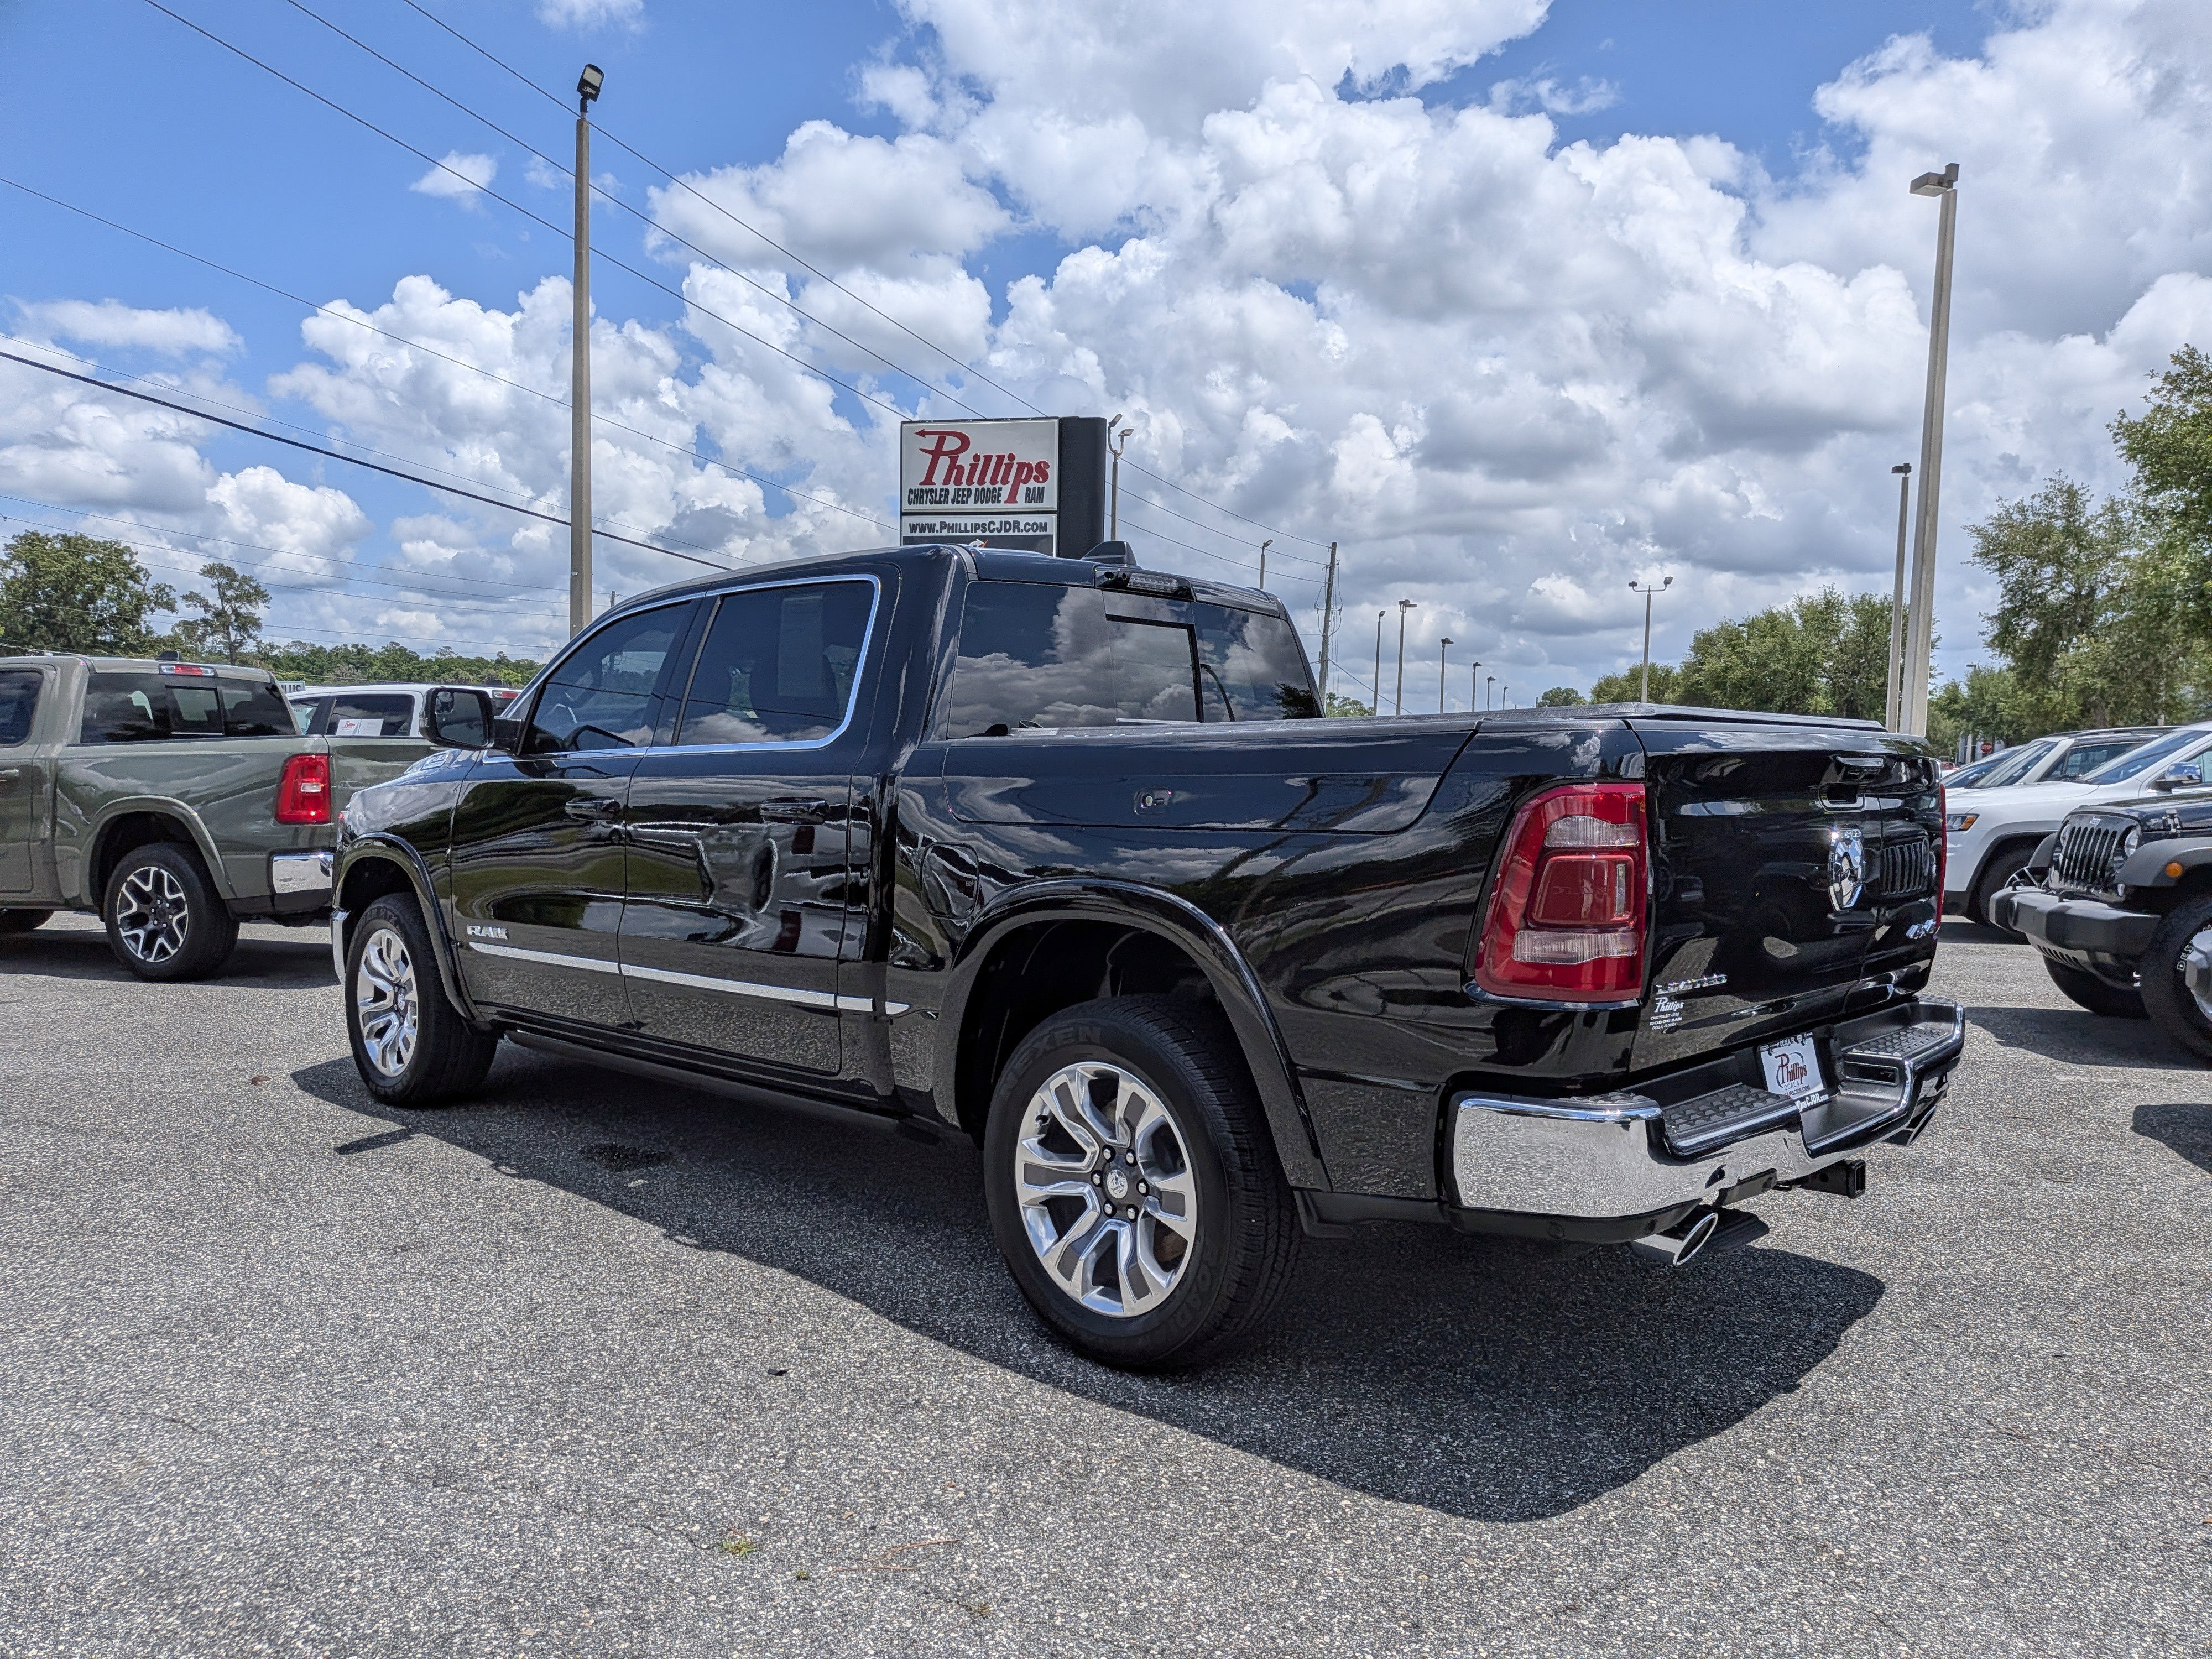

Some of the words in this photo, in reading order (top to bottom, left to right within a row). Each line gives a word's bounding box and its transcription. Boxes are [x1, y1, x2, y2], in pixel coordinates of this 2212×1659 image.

[914, 429, 1050, 504] Phillips
[907, 488, 950, 505] CHRYSLER
[951, 487, 972, 505] JEEP
[973, 487, 1003, 504] DODGE
[1024, 486, 1045, 504] RAM
[467, 925, 509, 940] RAM
[1655, 973, 1728, 995] LIMITED
[1654, 997, 1684, 1013] Phillips
[1775, 1053, 1808, 1084] Phillips
[1784, 1081, 1799, 1091] OCALA
